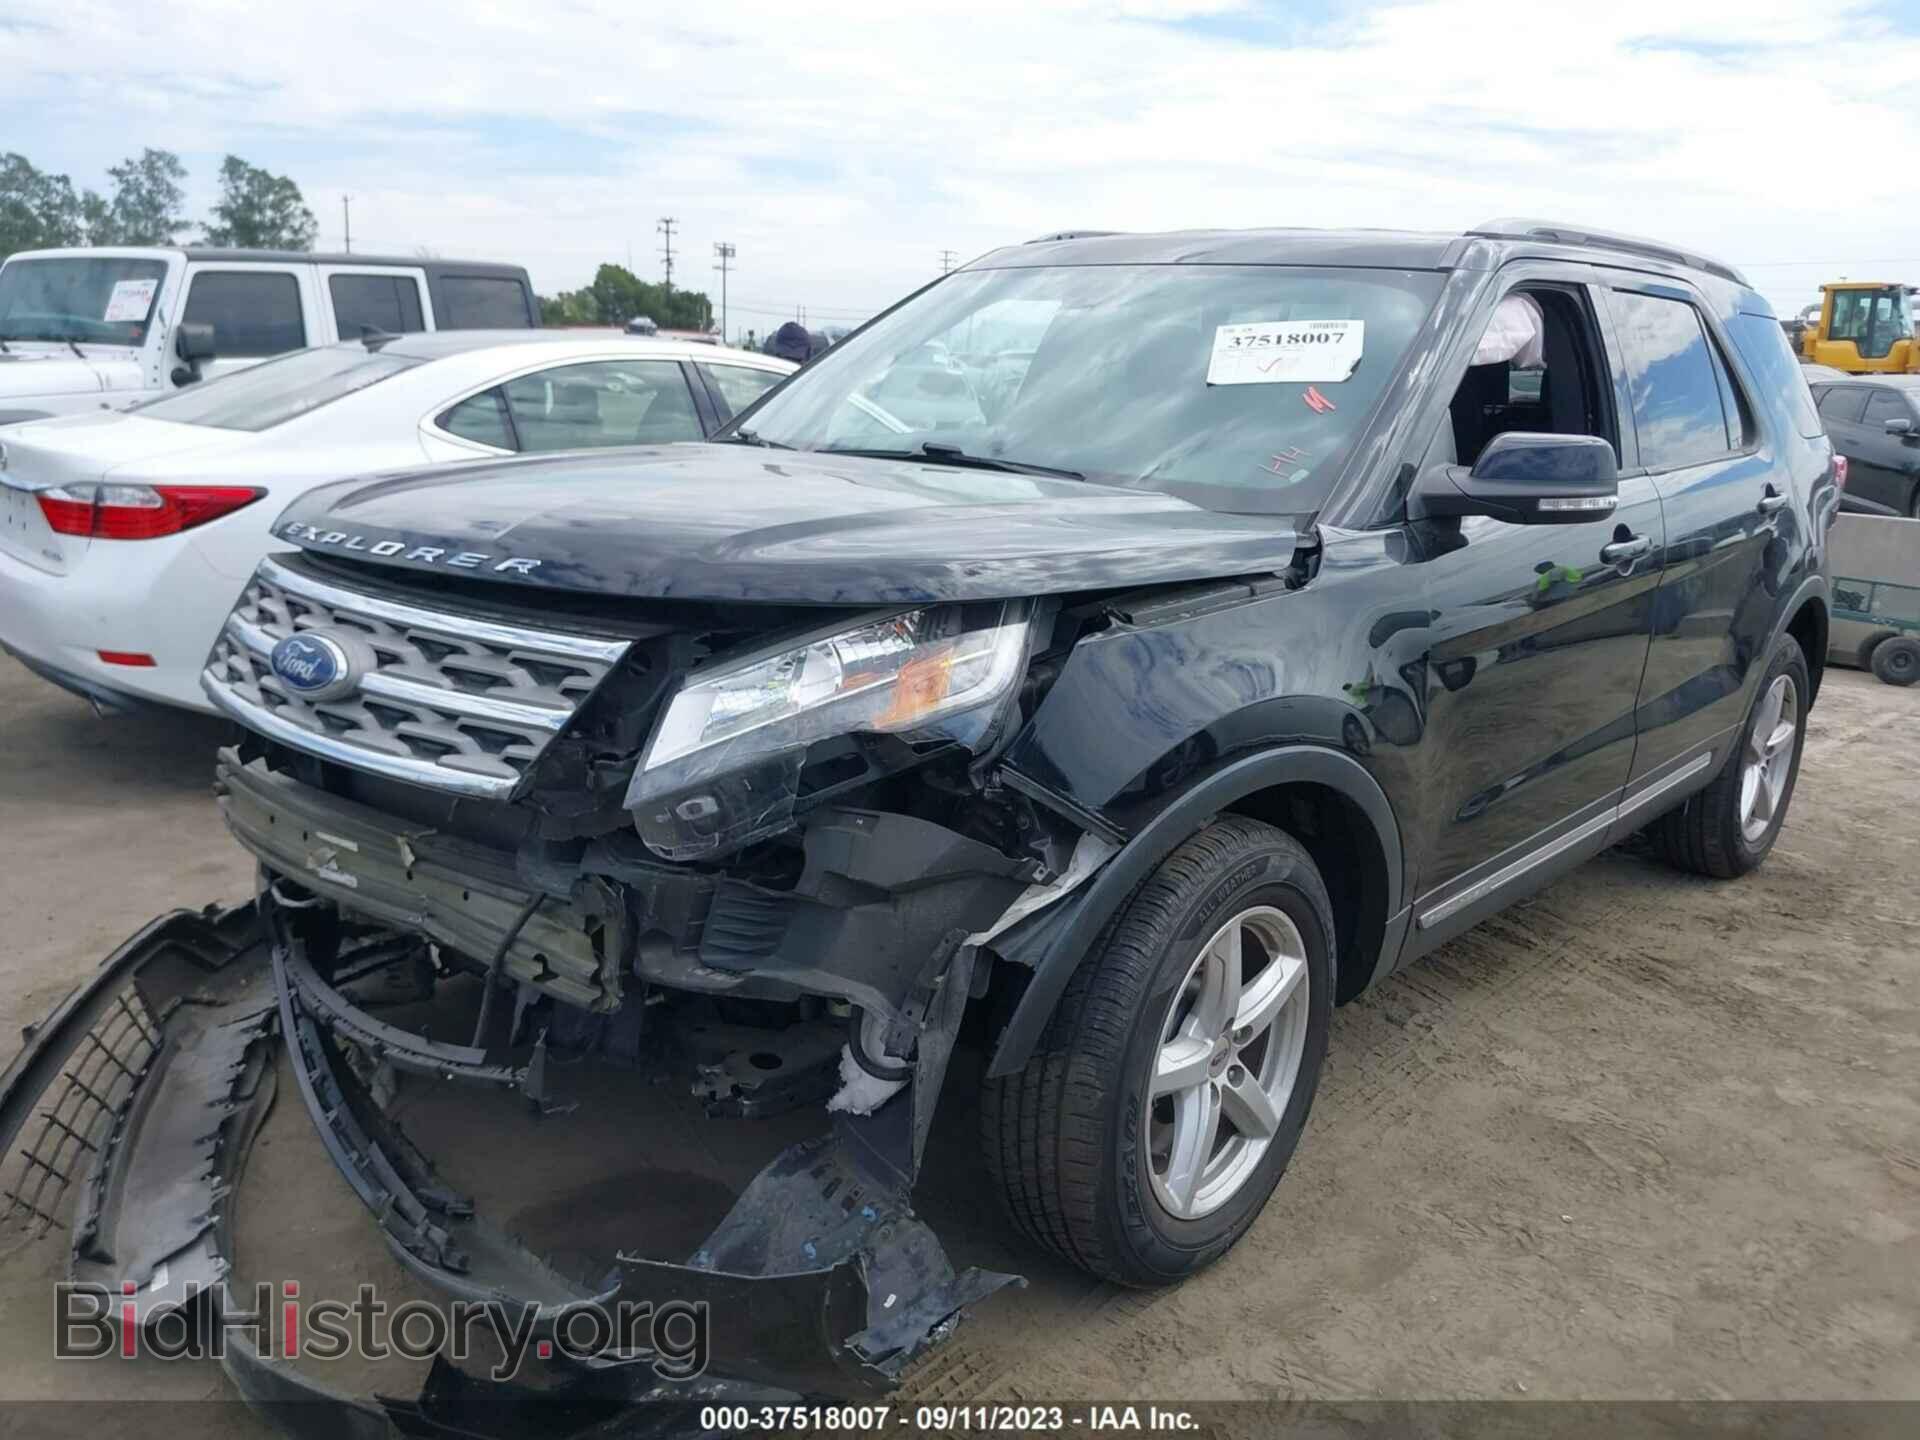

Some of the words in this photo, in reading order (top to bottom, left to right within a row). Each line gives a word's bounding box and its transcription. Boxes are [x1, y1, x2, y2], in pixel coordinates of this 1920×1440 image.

[1229, 332, 1345, 348] 37518007
[285, 521, 543, 575] EXPLORER
[279, 640, 322, 681] Ford
